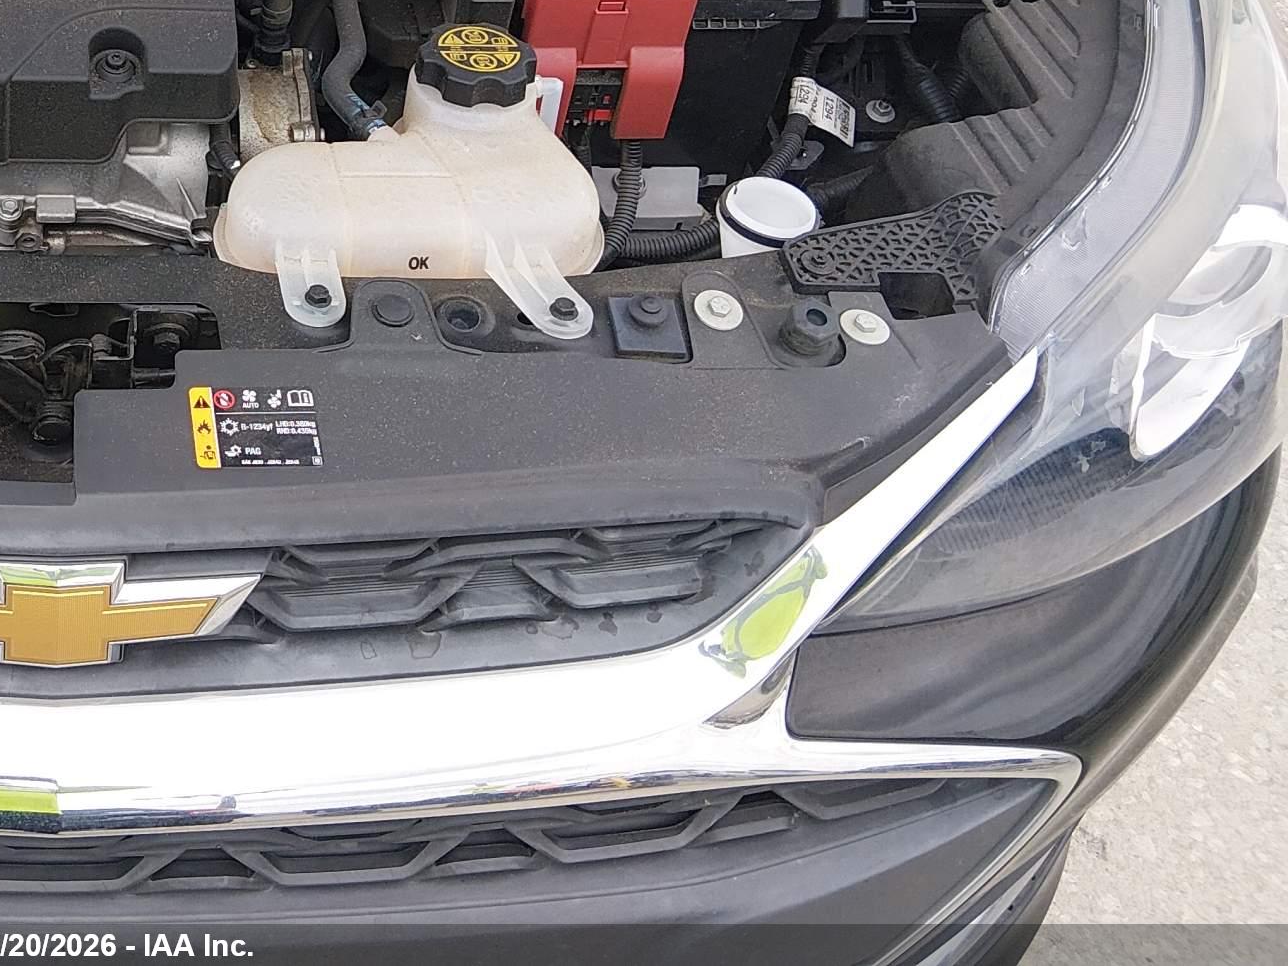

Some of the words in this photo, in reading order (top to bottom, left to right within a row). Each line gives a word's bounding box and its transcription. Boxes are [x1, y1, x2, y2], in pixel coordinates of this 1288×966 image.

[824, 97, 835, 121] 1294
[408, 256, 429, 270] OK
[244, 447, 262, 455] PAG
